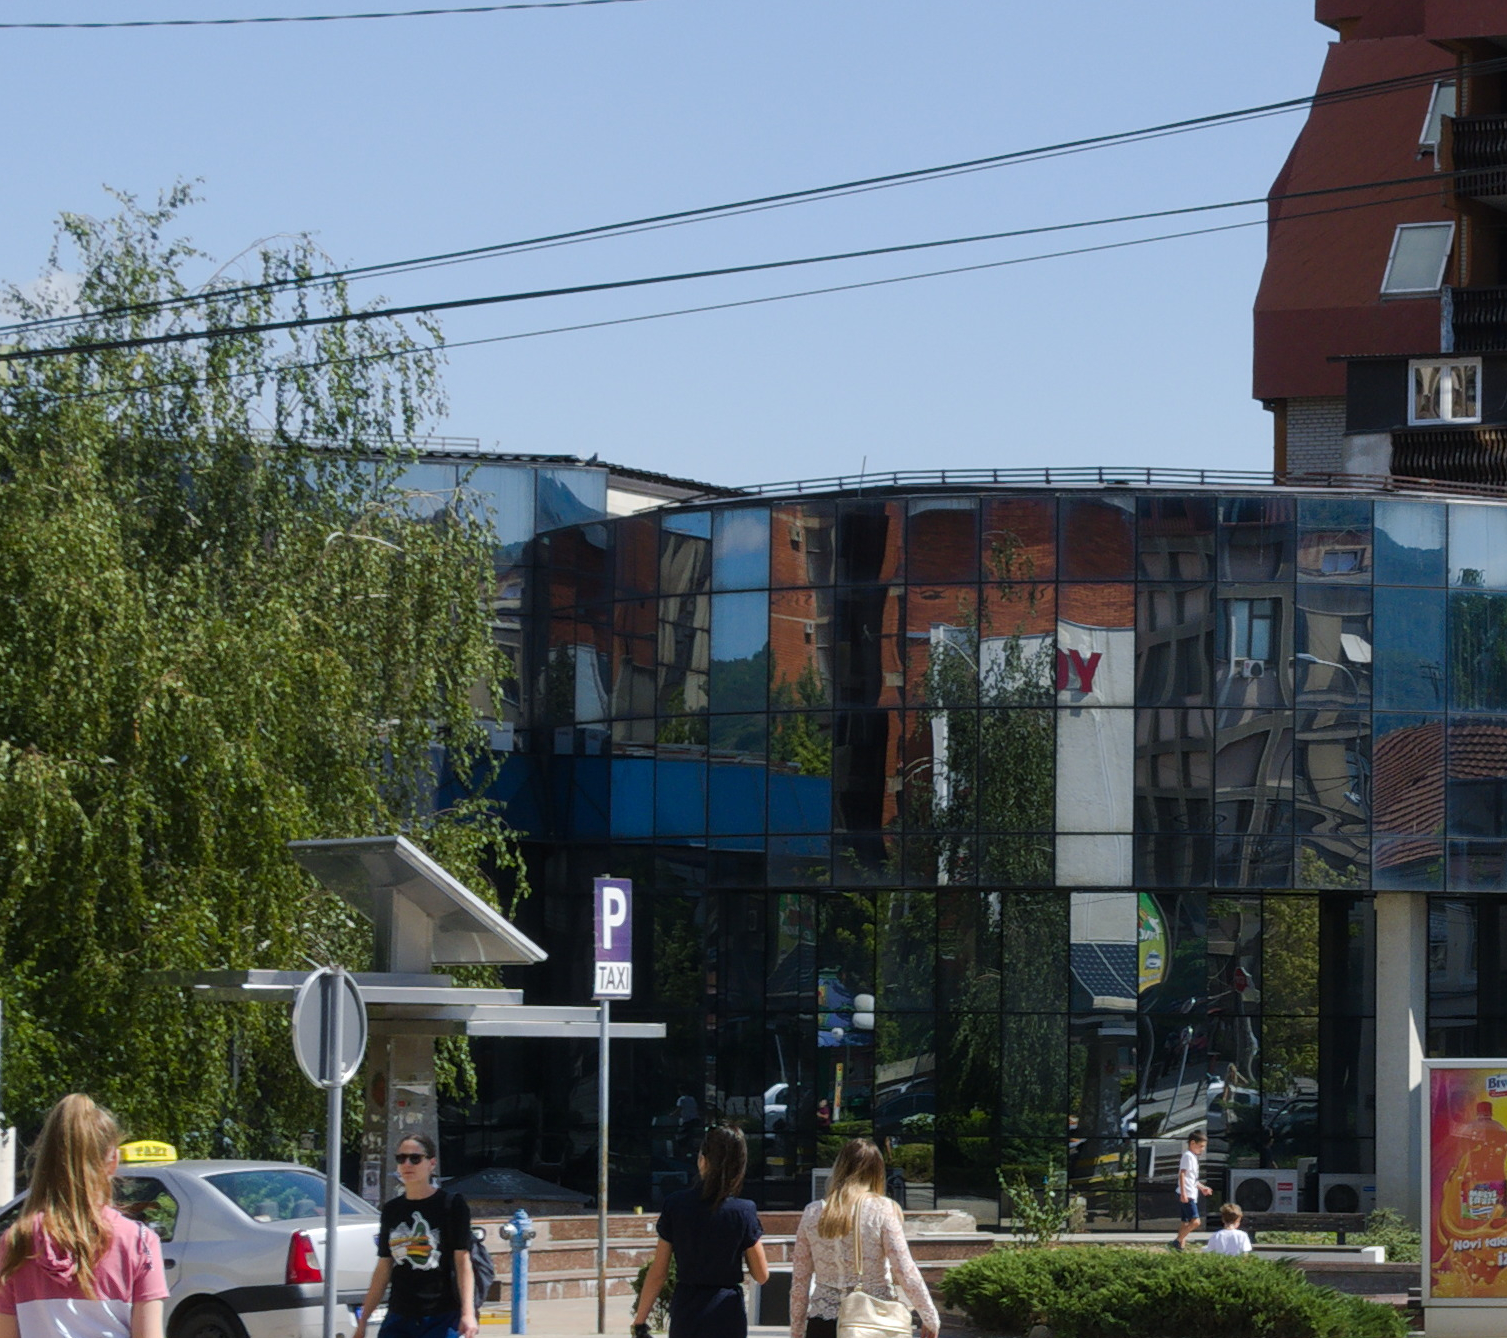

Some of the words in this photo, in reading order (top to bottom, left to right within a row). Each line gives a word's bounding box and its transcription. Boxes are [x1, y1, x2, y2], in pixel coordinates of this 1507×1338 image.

[603, 886, 627, 950] P
[598, 966, 629, 990] TAXI
[135, 1146, 167, 1156] TAXI
[1453, 1238, 1482, 1251] Novi
